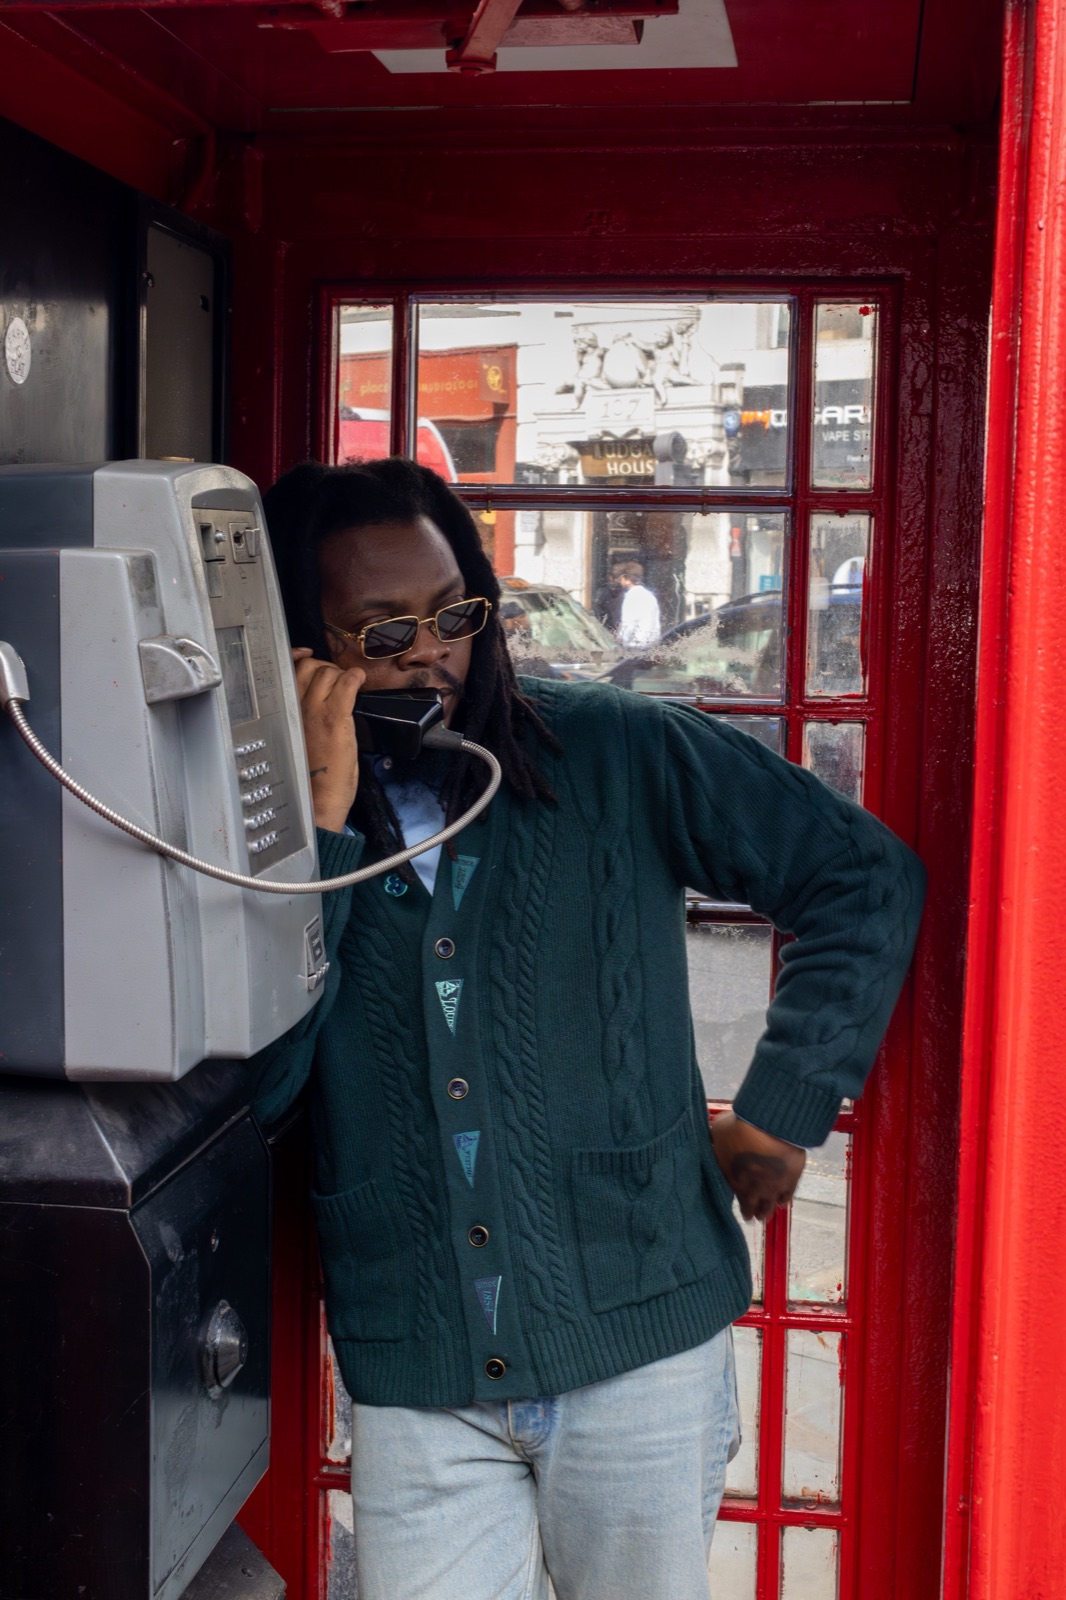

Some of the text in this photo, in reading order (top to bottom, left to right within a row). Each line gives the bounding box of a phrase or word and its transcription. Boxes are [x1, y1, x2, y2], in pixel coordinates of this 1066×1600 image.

[822, 430, 850, 442] VAPE
[593, 443, 655, 459] UDGA
[606, 459, 659, 475] HOUS
[483, 1290, 493, 1312] 1854
